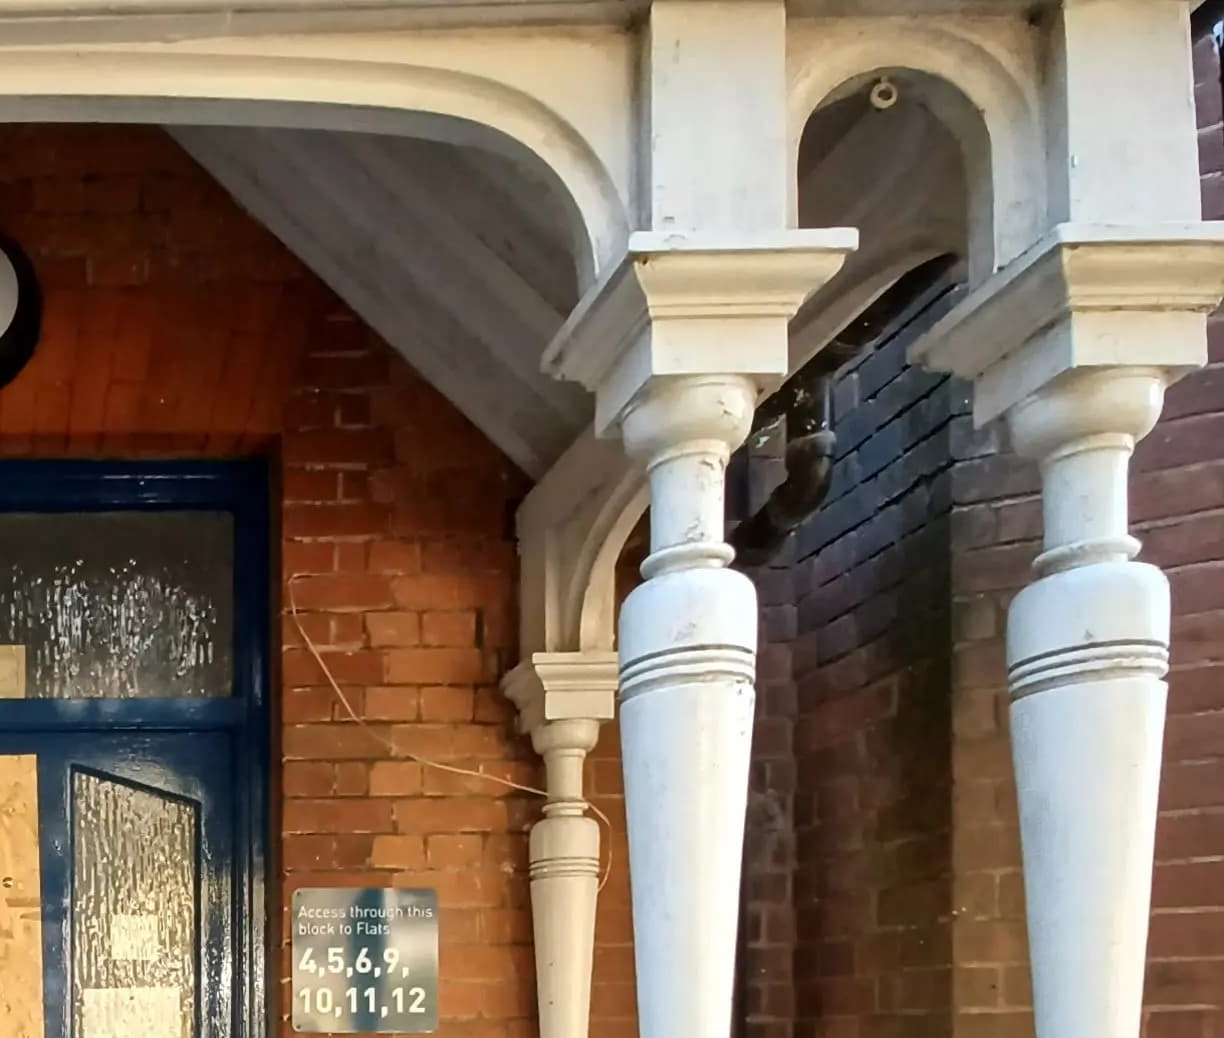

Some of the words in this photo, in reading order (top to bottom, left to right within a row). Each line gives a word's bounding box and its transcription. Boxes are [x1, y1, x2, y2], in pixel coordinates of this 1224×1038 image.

[297, 906, 346, 919] Access
[350, 905, 404, 921] through
[407, 905, 433, 918] this
[298, 923, 335, 936] block
[339, 924, 353, 936] to
[356, 922, 391, 936] Flats
